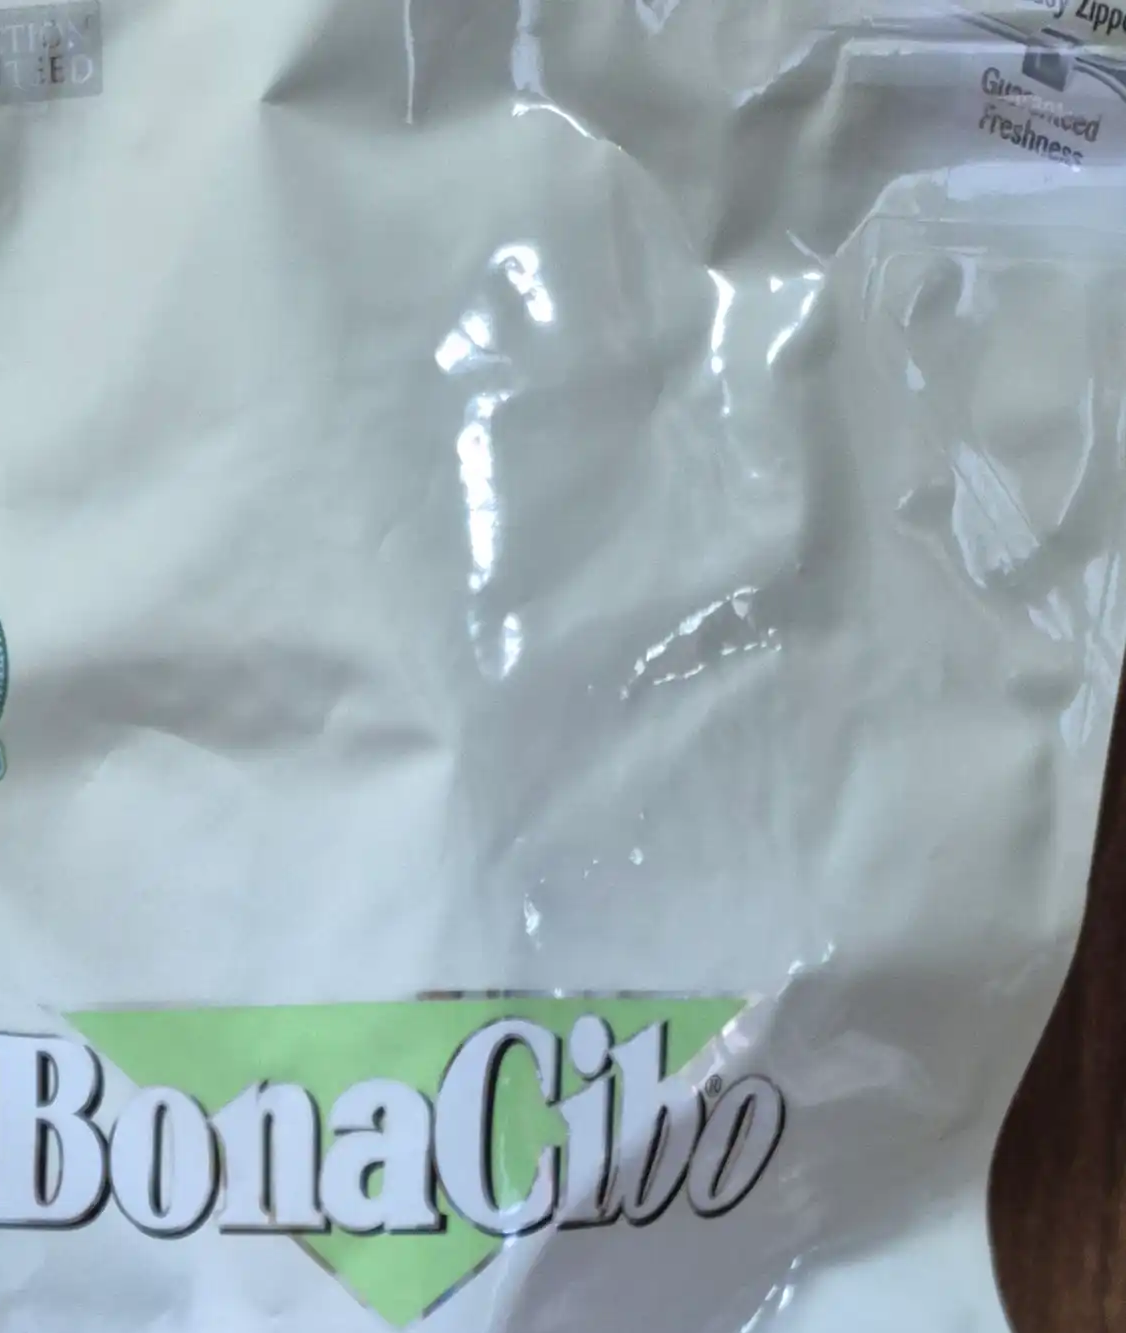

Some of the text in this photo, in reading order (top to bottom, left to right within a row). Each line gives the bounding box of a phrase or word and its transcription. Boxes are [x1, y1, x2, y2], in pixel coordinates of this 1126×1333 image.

[1075, 0, 1126, 36] Zipp
[978, 102, 1084, 165] Freshness
[981, 67, 1102, 142] Guteed
